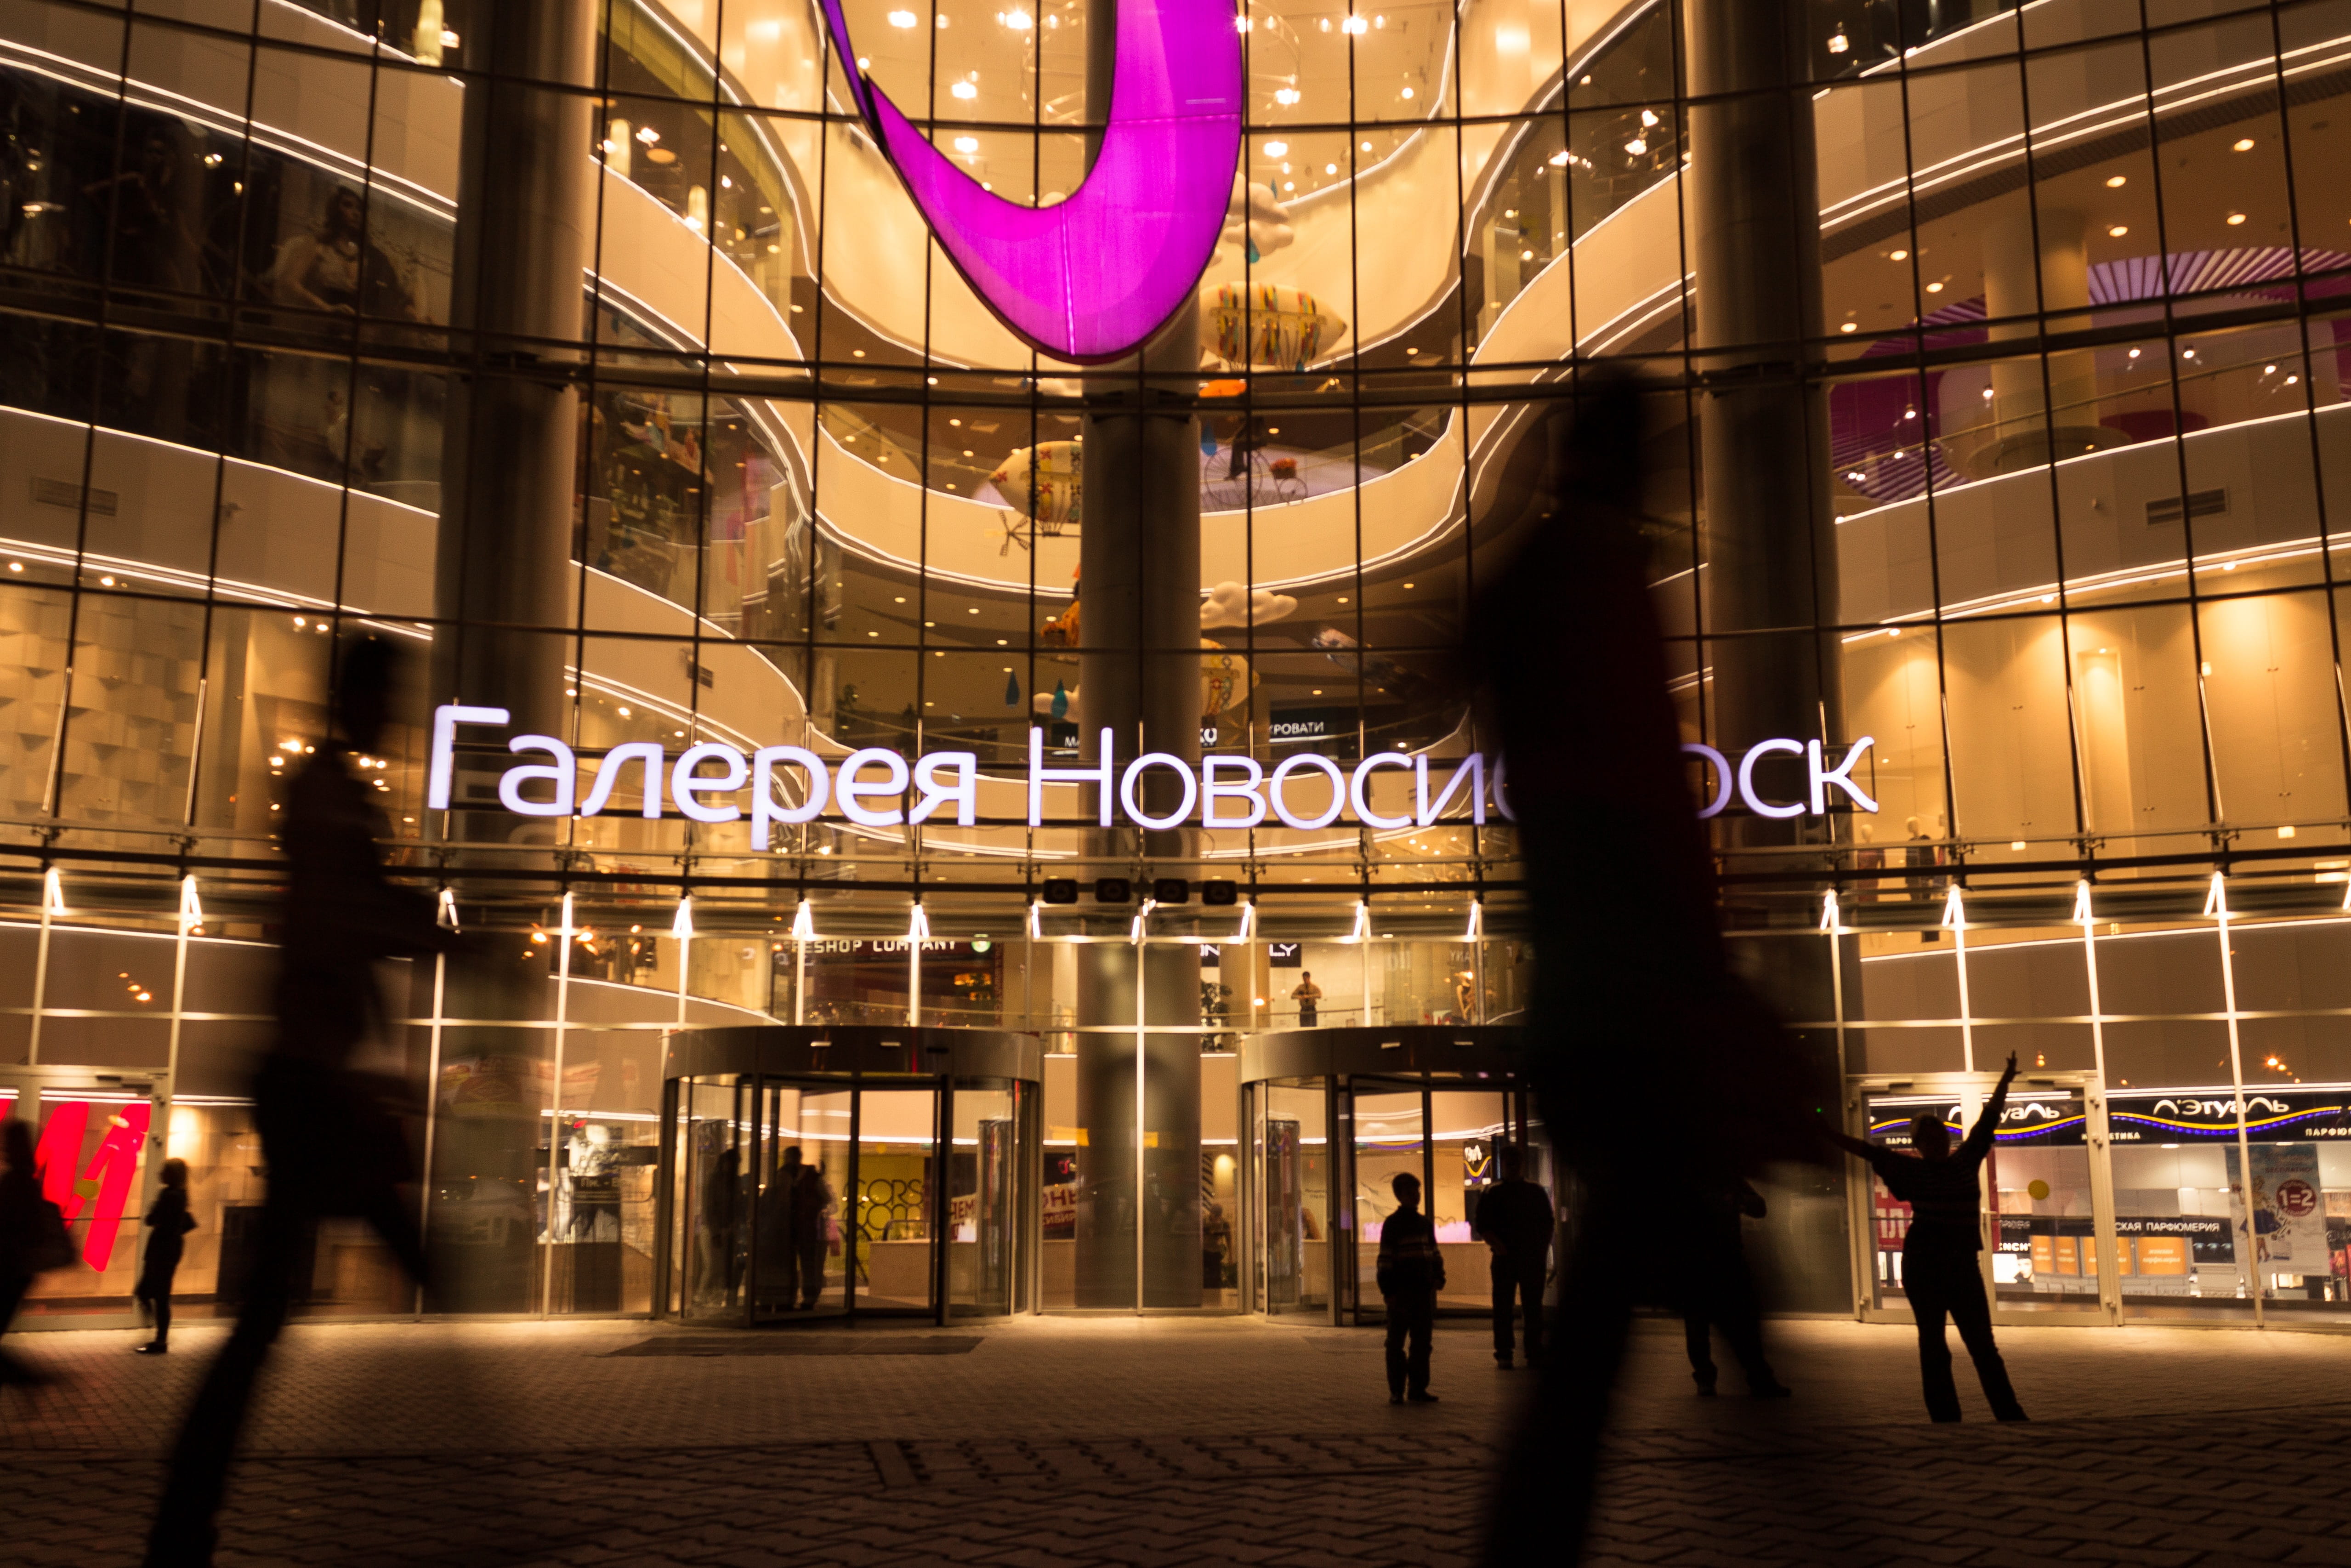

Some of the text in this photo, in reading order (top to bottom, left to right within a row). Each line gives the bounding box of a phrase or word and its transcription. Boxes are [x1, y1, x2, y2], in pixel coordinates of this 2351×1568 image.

[428, 704, 1879, 852] Галерея Новосиск
[2081, 1131, 2141, 1141] КЕТИКА
[2146, 1222, 2220, 1232] ПАРФЮМЕРИЯ
